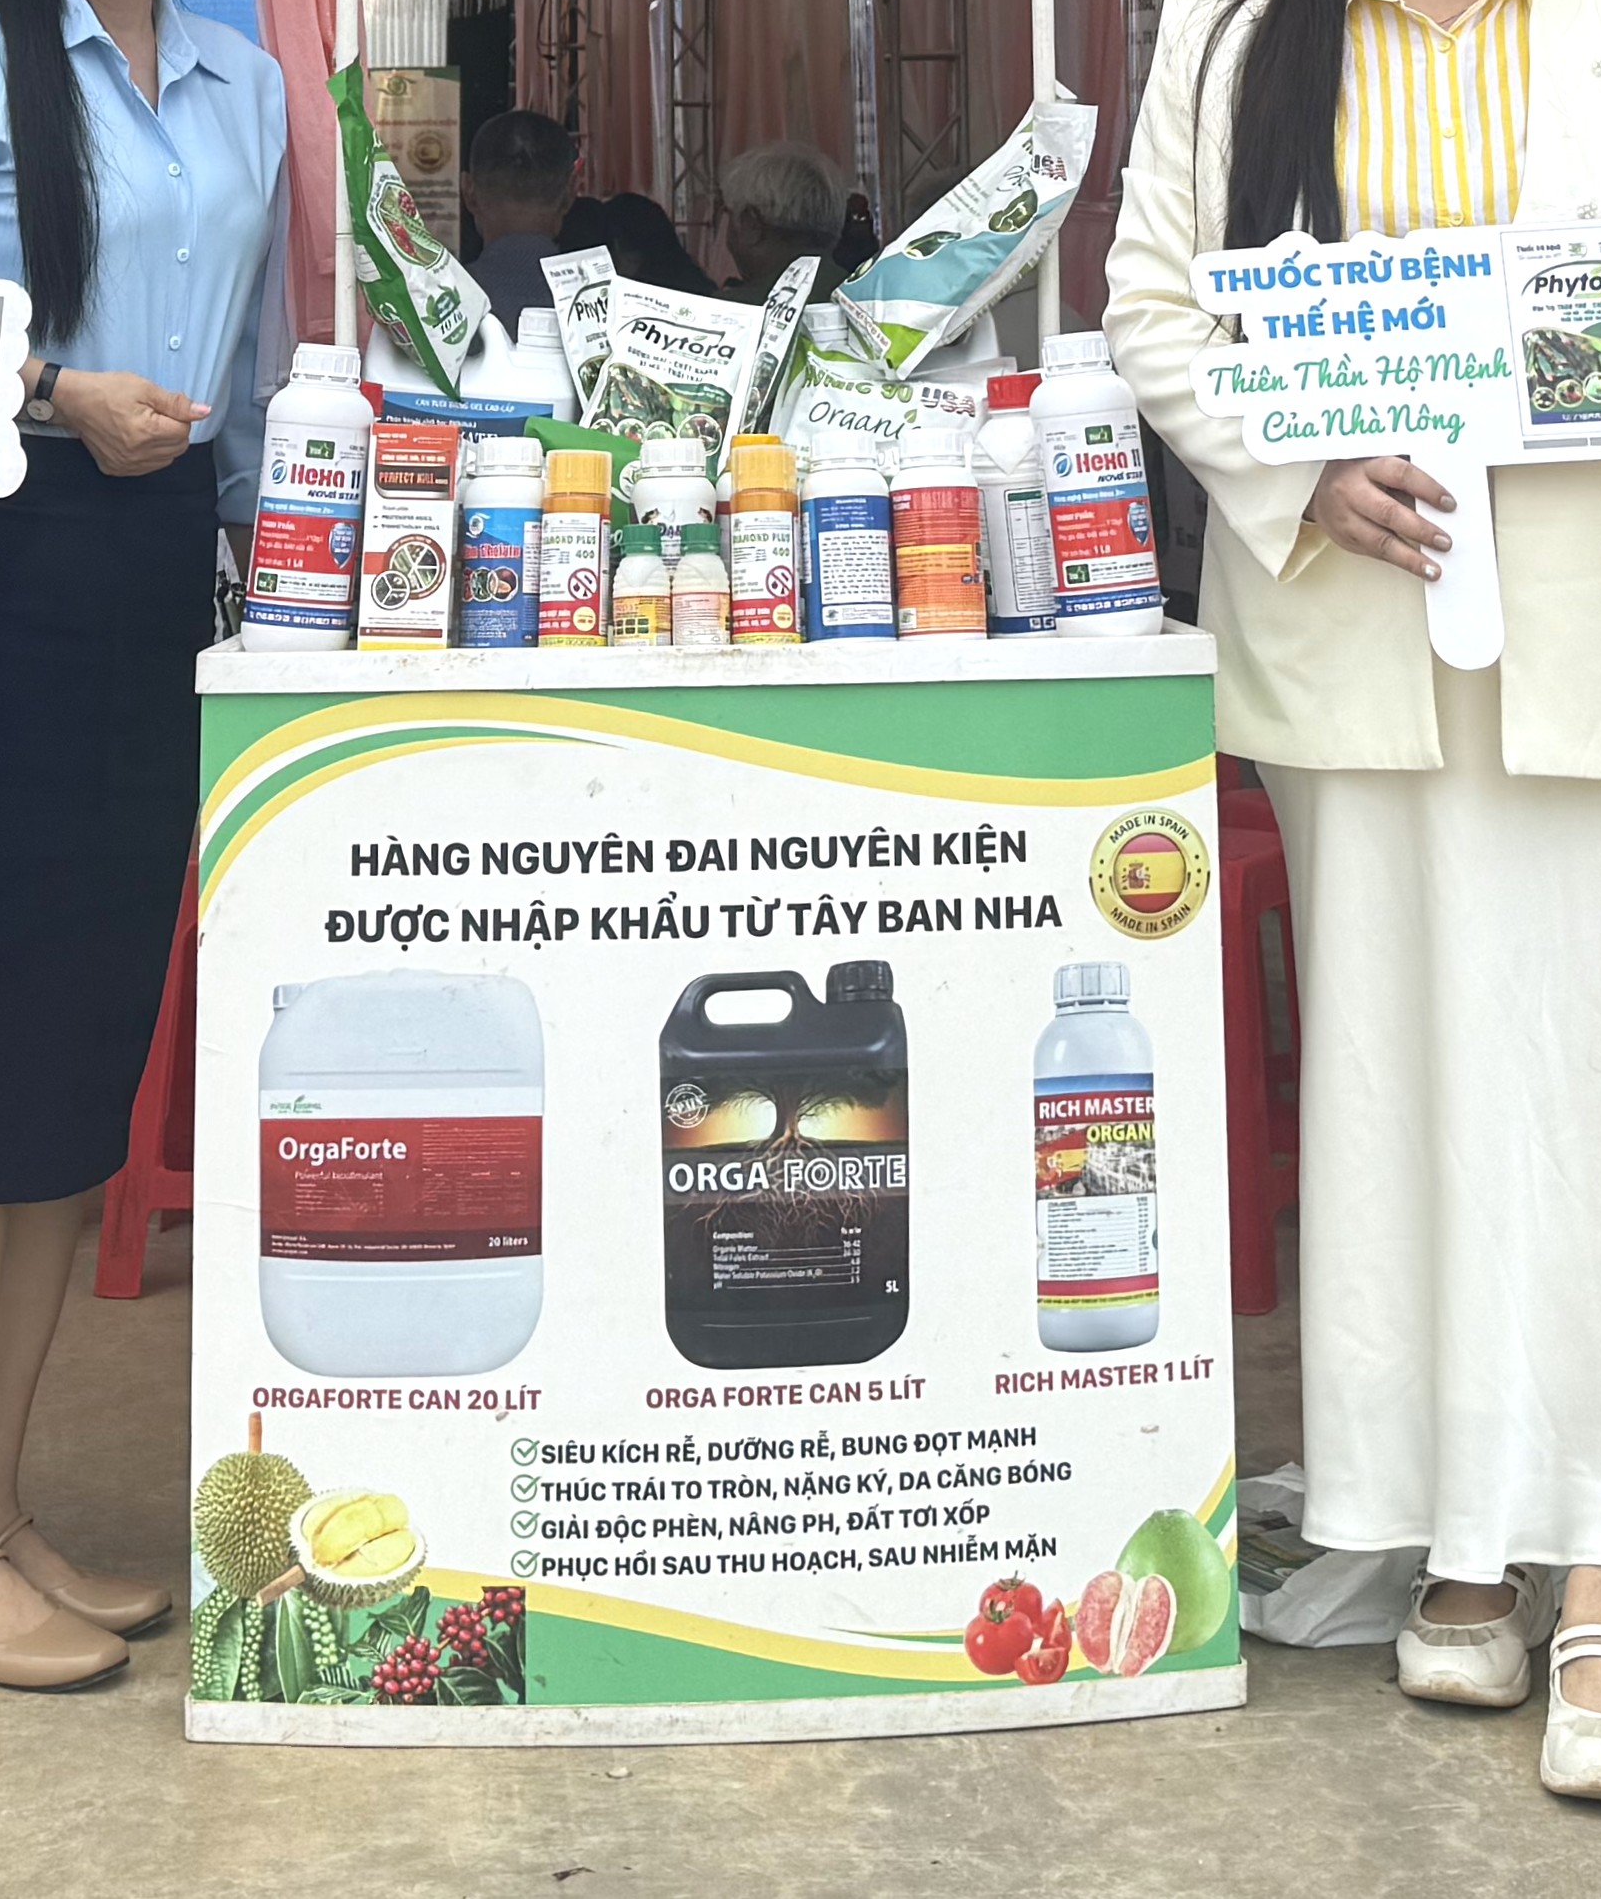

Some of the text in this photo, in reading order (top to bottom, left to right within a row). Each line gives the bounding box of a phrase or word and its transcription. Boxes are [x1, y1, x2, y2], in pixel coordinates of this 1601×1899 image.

[1209, 248, 1491, 294] THUỐC TRỪ BỆNH
[1263, 297, 1446, 341] THẾ HỆ MỚI
[630, 320, 736, 359] Phytora
[1208, 348, 1512, 396] Thiên Thần Hộ Mệnh
[1263, 404, 1465, 444] Của Nhà Nông
[1110, 815, 1189, 843] MADE IN SPAIN
[351, 824, 1026, 876] HÀNG NGUYÊN ĐAI NGUYÊN KIỆN
[325, 891, 1062, 952] ĐƯỢC NHẬP KHẨU TỪ TÂY BAN NHA
[1111, 904, 1191, 933] MADE IN SPAIN
[1038, 1095, 1155, 1120] RICH MASTER
[279, 1137, 407, 1166] OrgaForte
[669, 1154, 907, 1194] ORGA FORTE
[646, 1373, 926, 1410] ORGA FORTE CAN 5 LÍT
[995, 1354, 1214, 1395] RICH MASTER 1 LÍT
[252, 1383, 542, 1410] ORGAFORTE CAN 20 LÍT
[541, 1427, 1036, 1465] SIÊU KÍCH RỄ, DƯỠNG RỄ, BUNG ĐỌT MẠNH
[541, 1460, 1072, 1502] THÚC TRÁI TO TRÒN, NẶNG KÝ, DA CĂNG BÓNG
[542, 1498, 990, 1543] GIẢI ĐỘC PHÈN, NÂNG PH, ĐẤT TƠI XỐP
[542, 1534, 1057, 1582] PHỤC SAU THU HOẠCH, SAU NHIỄM MẶN
